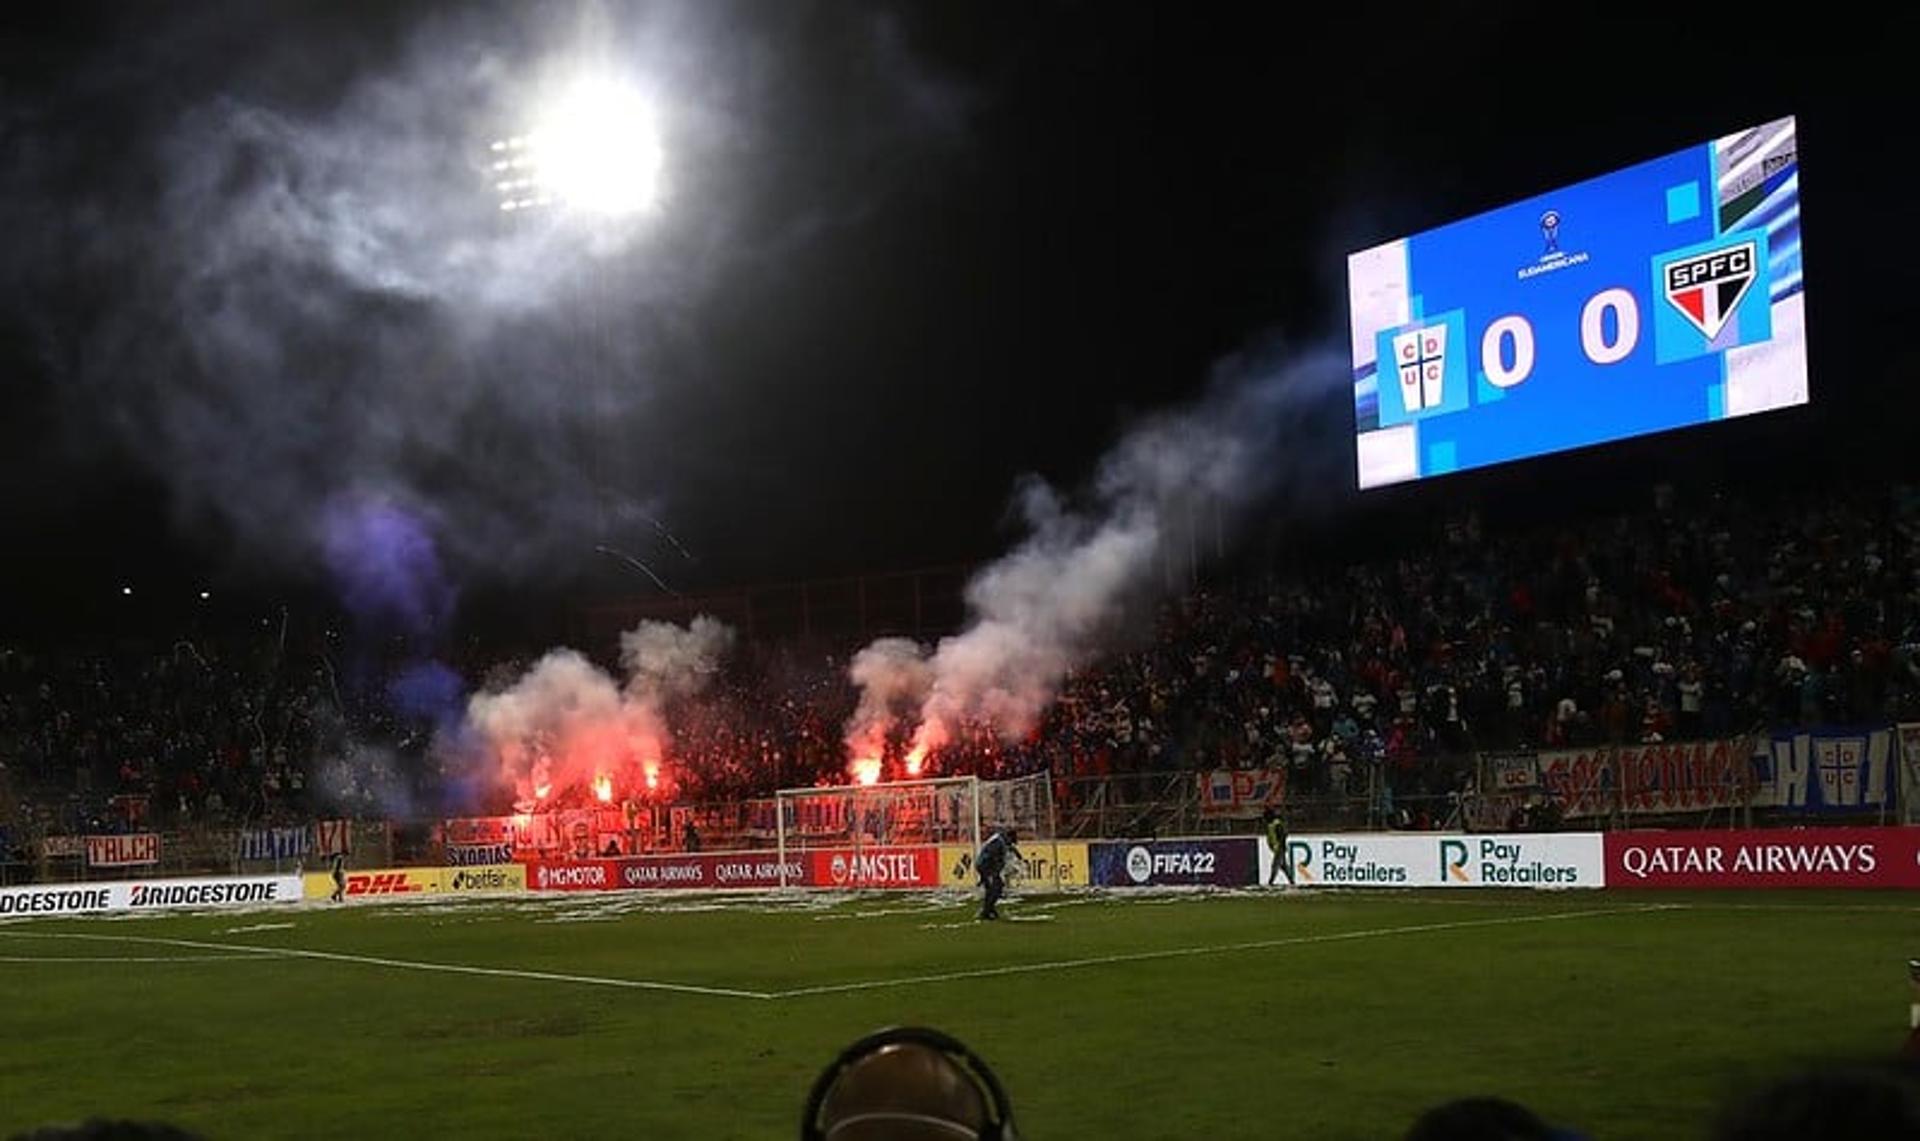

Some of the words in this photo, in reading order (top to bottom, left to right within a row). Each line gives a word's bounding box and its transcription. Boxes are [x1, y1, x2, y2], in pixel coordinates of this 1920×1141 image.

[1672, 252, 1747, 288] SPFC
[1481, 314, 1535, 388] 0
[1580, 287, 1640, 365] 0
[1322, 841, 1358, 862] Pay
[1480, 839, 1522, 863] Pay
[1622, 846, 1725, 878] QATAR
[1732, 845, 1876, 873] AIRWAYS
[625, 867, 659, 884] QATAR
[659, 864, 703, 881] AIRWAYS
[715, 863, 753, 882] QATAR
[850, 854, 920, 881] AMSTEL
[1322, 862, 1408, 882] Retailers
[1481, 862, 1578, 883] Retailers
[129, 881, 279, 906] BRIDGESTONE
[346, 874, 410, 895] DHL
